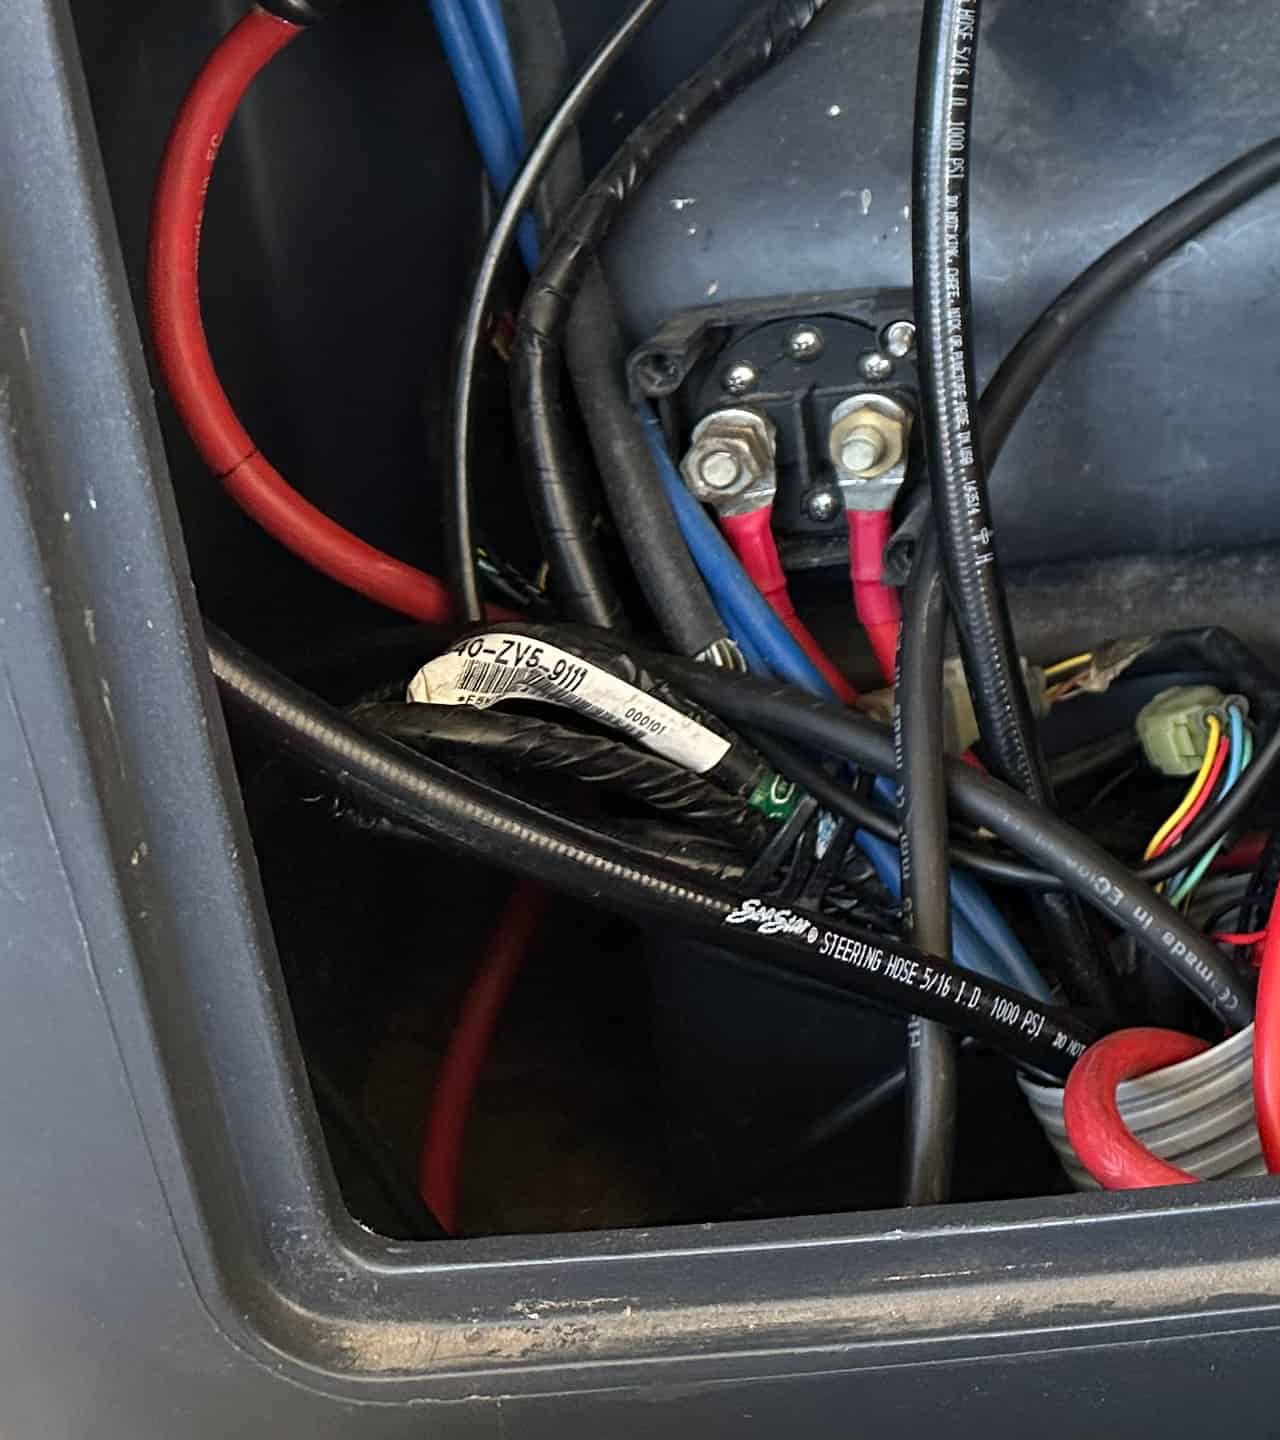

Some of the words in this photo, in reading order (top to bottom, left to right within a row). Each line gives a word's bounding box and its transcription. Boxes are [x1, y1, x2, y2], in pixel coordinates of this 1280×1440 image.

[957, 8, 977, 41] HOSE
[951, 46, 972, 76] 5/16
[946, 120, 967, 151] 1000
[945, 157, 965, 179] PSI
[624, 706, 667, 736] 000101
[1160, 930, 1215, 983] made
[818, 931, 882, 973] STEERING
[886, 953, 918, 985] HOSE
[919, 966, 951, 998] 5/16
[989, 997, 1019, 1025] 1000
[1021, 1011, 1046, 1037] PSI
